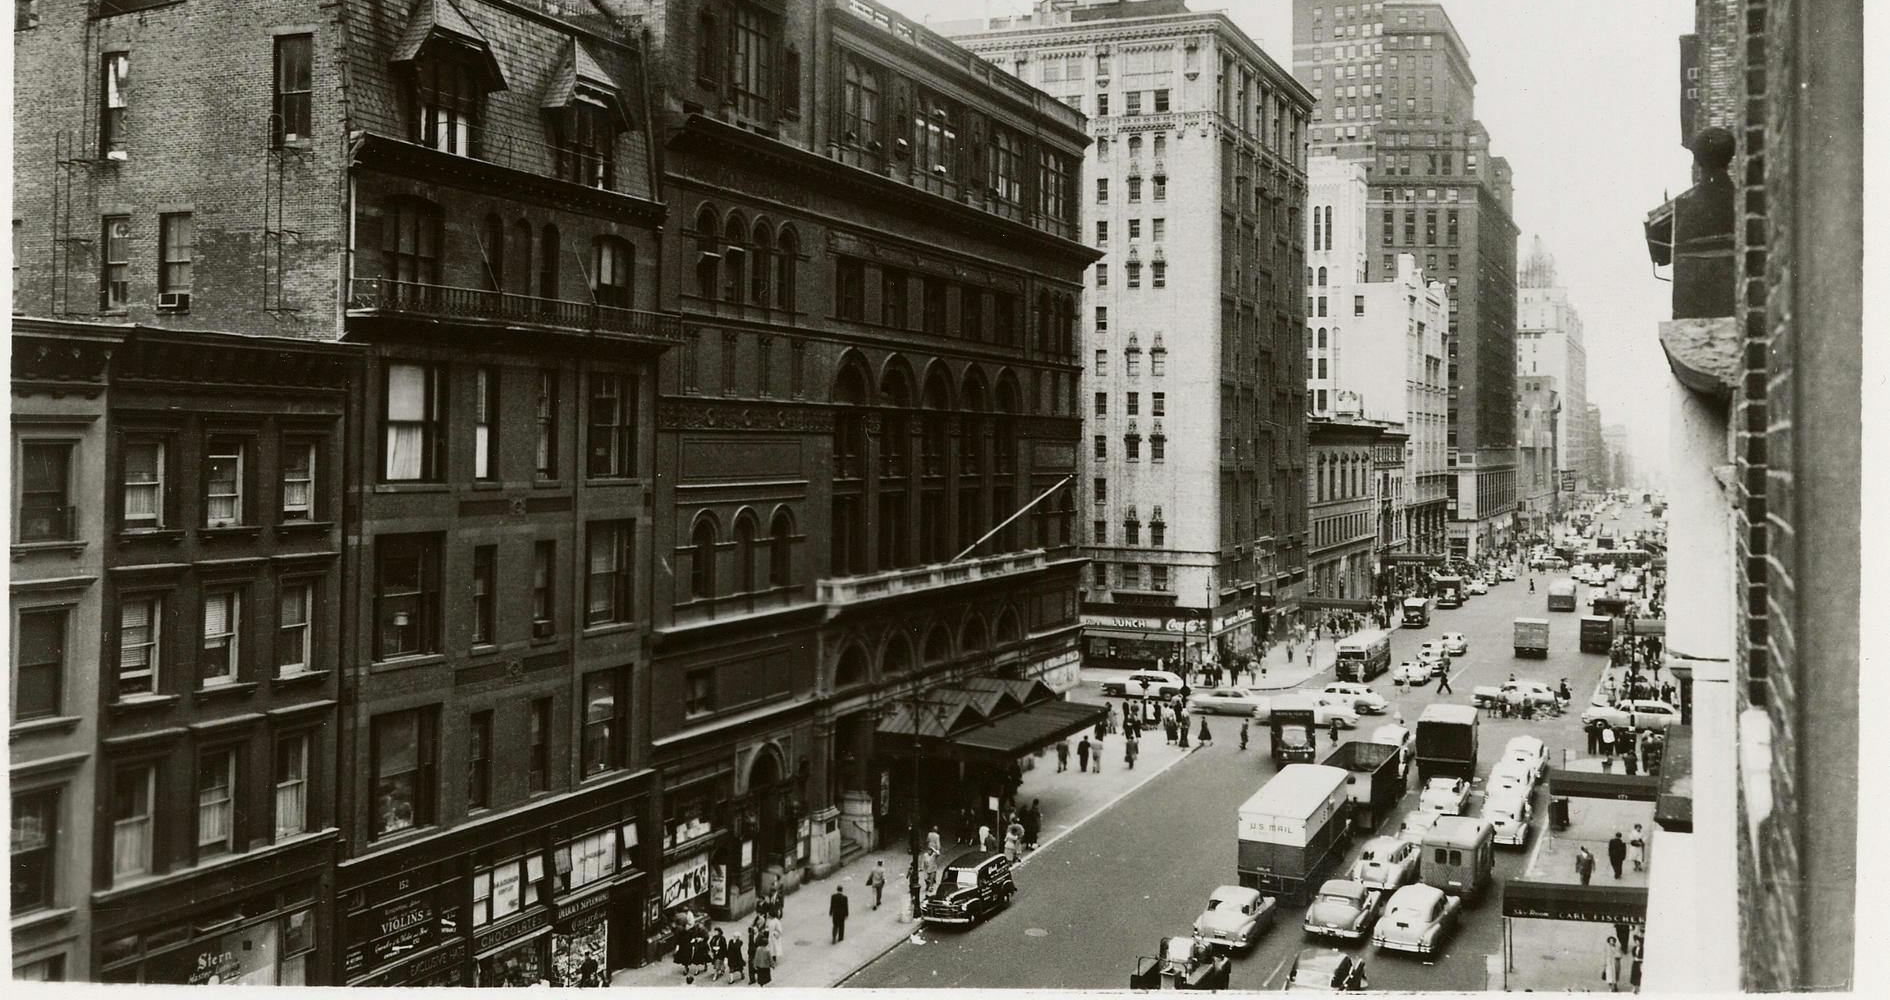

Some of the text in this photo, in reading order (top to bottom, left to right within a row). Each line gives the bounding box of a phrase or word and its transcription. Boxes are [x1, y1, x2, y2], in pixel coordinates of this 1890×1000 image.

[1111, 618, 1146, 629] LUNCH
[1269, 824, 1293, 834] MAIL
[398, 880, 409, 890] 152
[381, 910, 424, 934] VIOLINS
[1559, 912, 1645, 923] CARL FISCHER
[480, 914, 543, 948] CHOCOLATES
[197, 951, 232, 971] Stern
